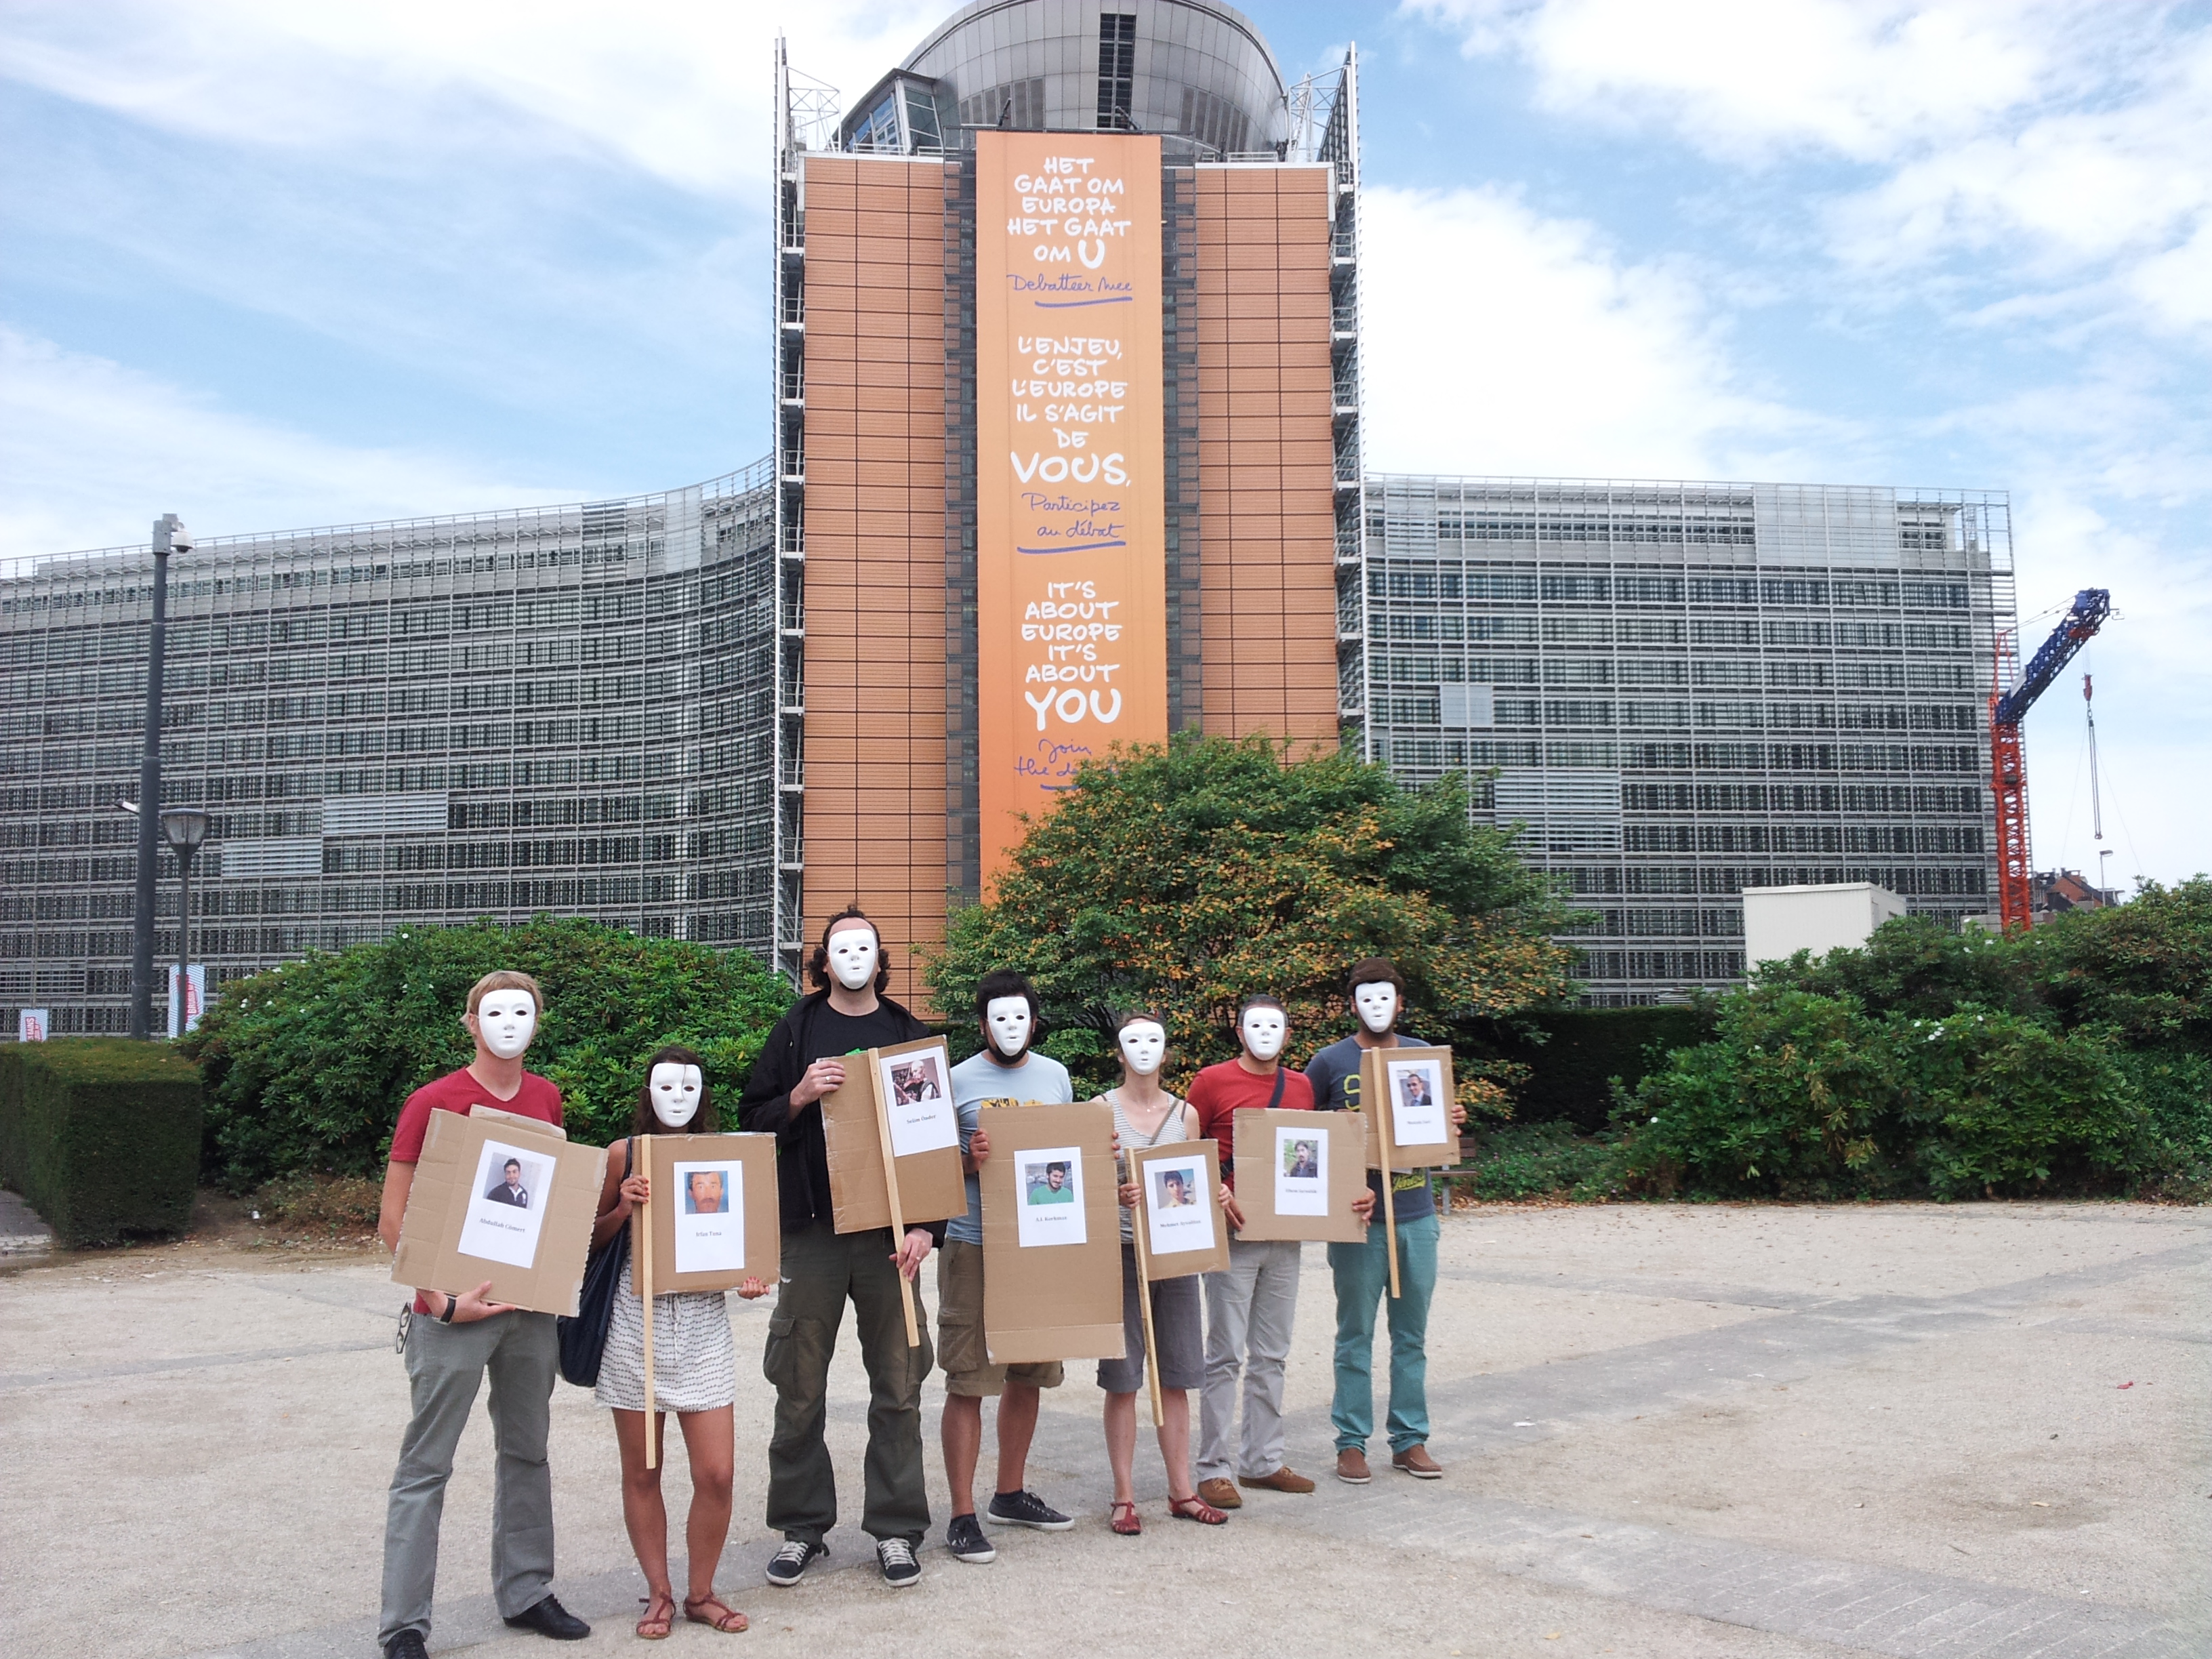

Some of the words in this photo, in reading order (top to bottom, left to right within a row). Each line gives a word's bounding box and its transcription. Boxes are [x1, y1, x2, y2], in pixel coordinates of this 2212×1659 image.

[1044, 156, 1094, 174] HET
[1014, 174, 1082, 194] GAAT
[1087, 177, 1124, 194] OM
[1021, 197, 1115, 216] EUROPA
[1007, 217, 1058, 235] HET
[1064, 217, 1132, 237] GAAT
[1033, 245, 1071, 262] OM
[1078, 238, 1106, 269] U
[1006, 273, 1093, 291] Debatteer
[1018, 336, 1122, 360] L'ENJEU,
[1033, 359, 1107, 376] C'EST
[1012, 379, 1128, 398] L'EUROPE
[1017, 404, 1037, 422] IL
[1044, 403, 1124, 423] S'AGIT
[1052, 428, 1089, 449] DE
[1010, 451, 1131, 487] VOUS,
[1021, 492, 1120, 517] Participez
[1036, 525, 1061, 537] au
[1066, 520, 1125, 537] débat
[1048, 581, 1097, 598] IT'S
[1025, 601, 1119, 619] ABOUT
[1021, 623, 1122, 641] EUROPE
[1048, 643, 1097, 661] IT'S
[1025, 664, 1120, 682] ABOUT
[1025, 686, 1122, 731] YOU
[1038, 738, 1092, 763] Join
[1014, 756, 1050, 776] the
[479, 1218, 504, 1228] Abdullah
